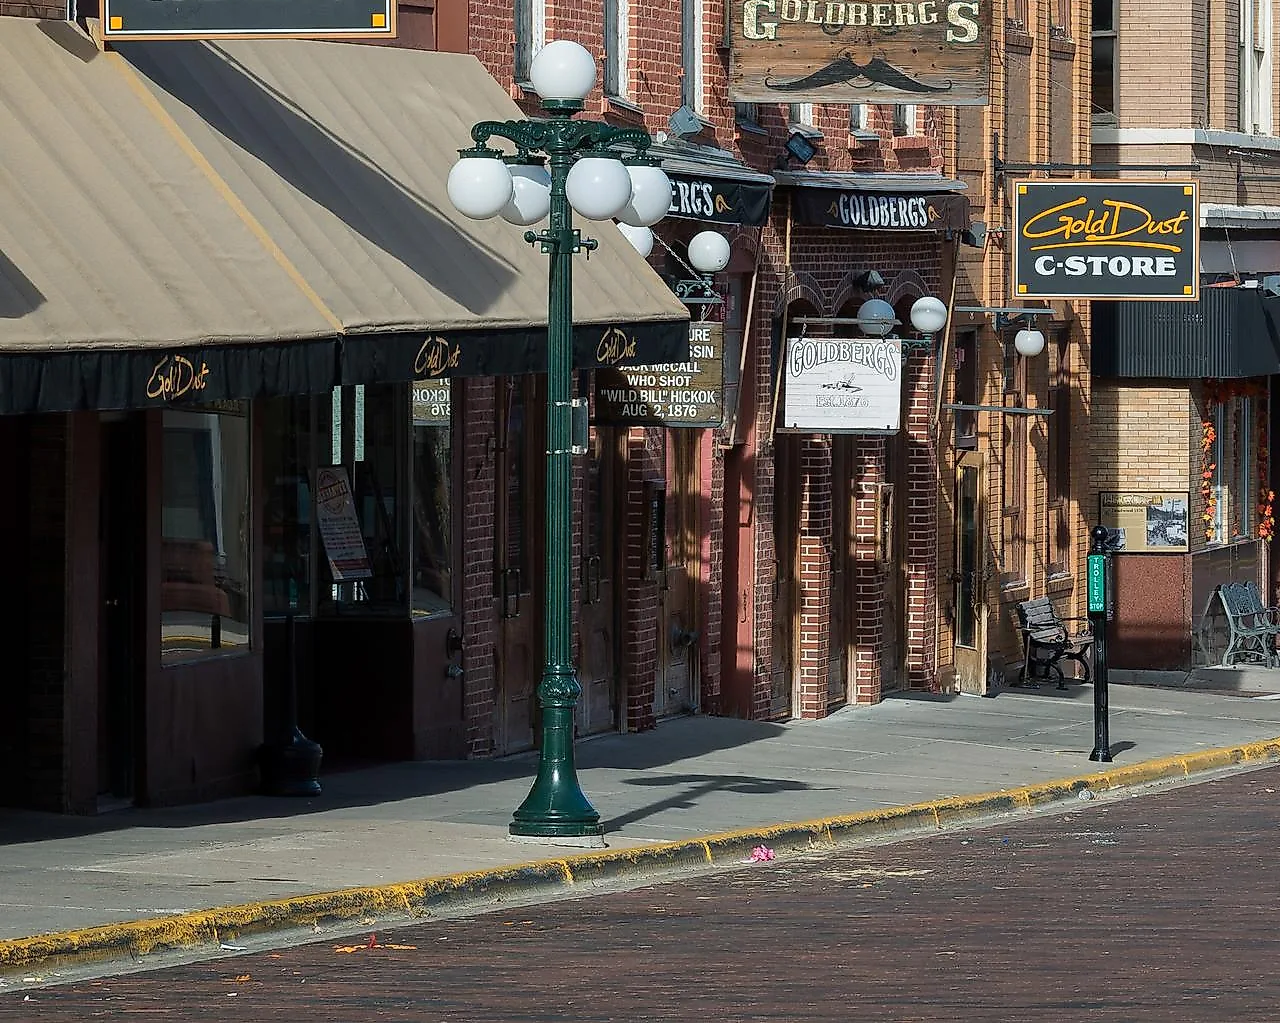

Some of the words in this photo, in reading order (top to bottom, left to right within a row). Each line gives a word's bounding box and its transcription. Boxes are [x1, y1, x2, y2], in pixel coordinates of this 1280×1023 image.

[1022, 197, 1110, 240] Gold
[1085, 199, 1190, 241] Dust
[1034, 255, 1177, 277] C-STORE
[627, 375, 656, 387] WHO
[659, 376, 692, 387] SHOT
[601, 390, 637, 403] "WILD
[640, 390, 668, 403] BILL"
[670, 390, 715, 403] HICKOK
[622, 404, 648, 417] AUG
[653, 405, 665, 419] 2,
[667, 405, 697, 417] 1876
[1089, 602, 1104, 610] STOP
